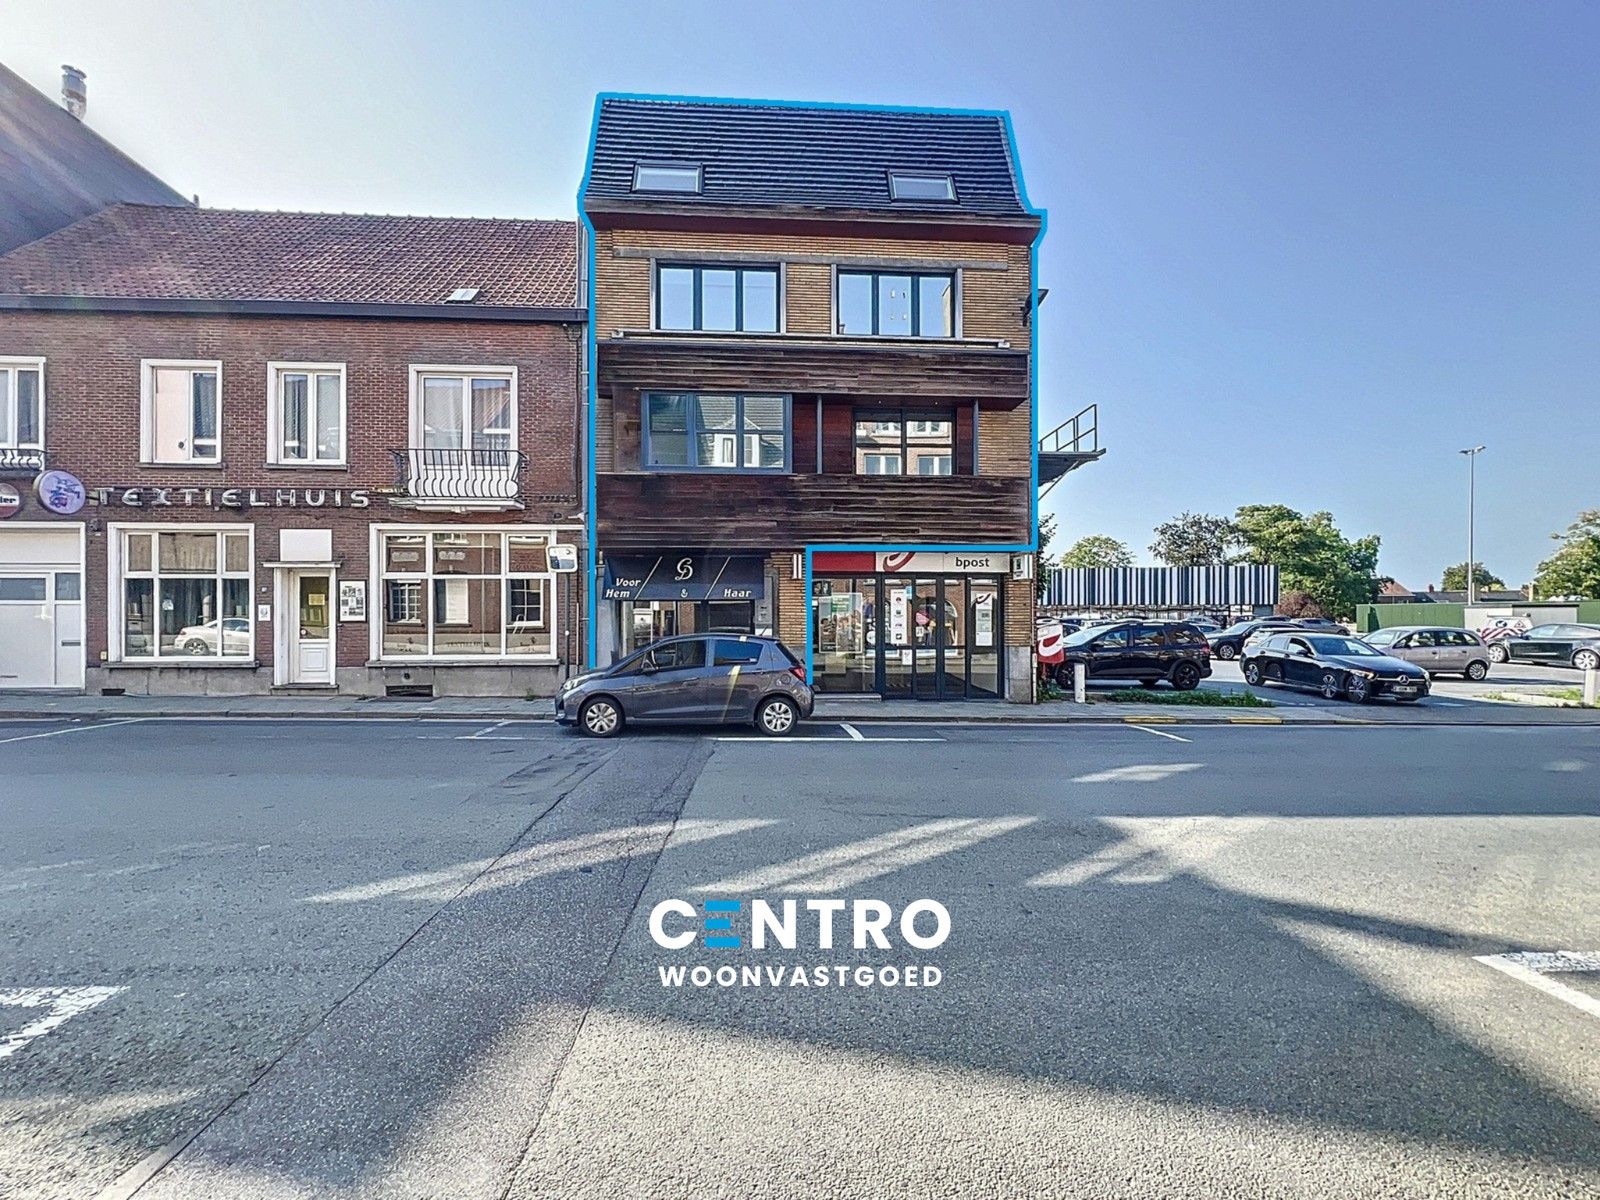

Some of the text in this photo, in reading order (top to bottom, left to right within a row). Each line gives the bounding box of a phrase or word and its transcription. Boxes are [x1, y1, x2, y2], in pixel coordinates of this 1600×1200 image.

[97, 488, 370, 508] TEXTIELHUIS
[955, 557, 990, 570] bpost
[616, 578, 642, 587] Voor
[606, 589, 752, 598] Hem & Haar
